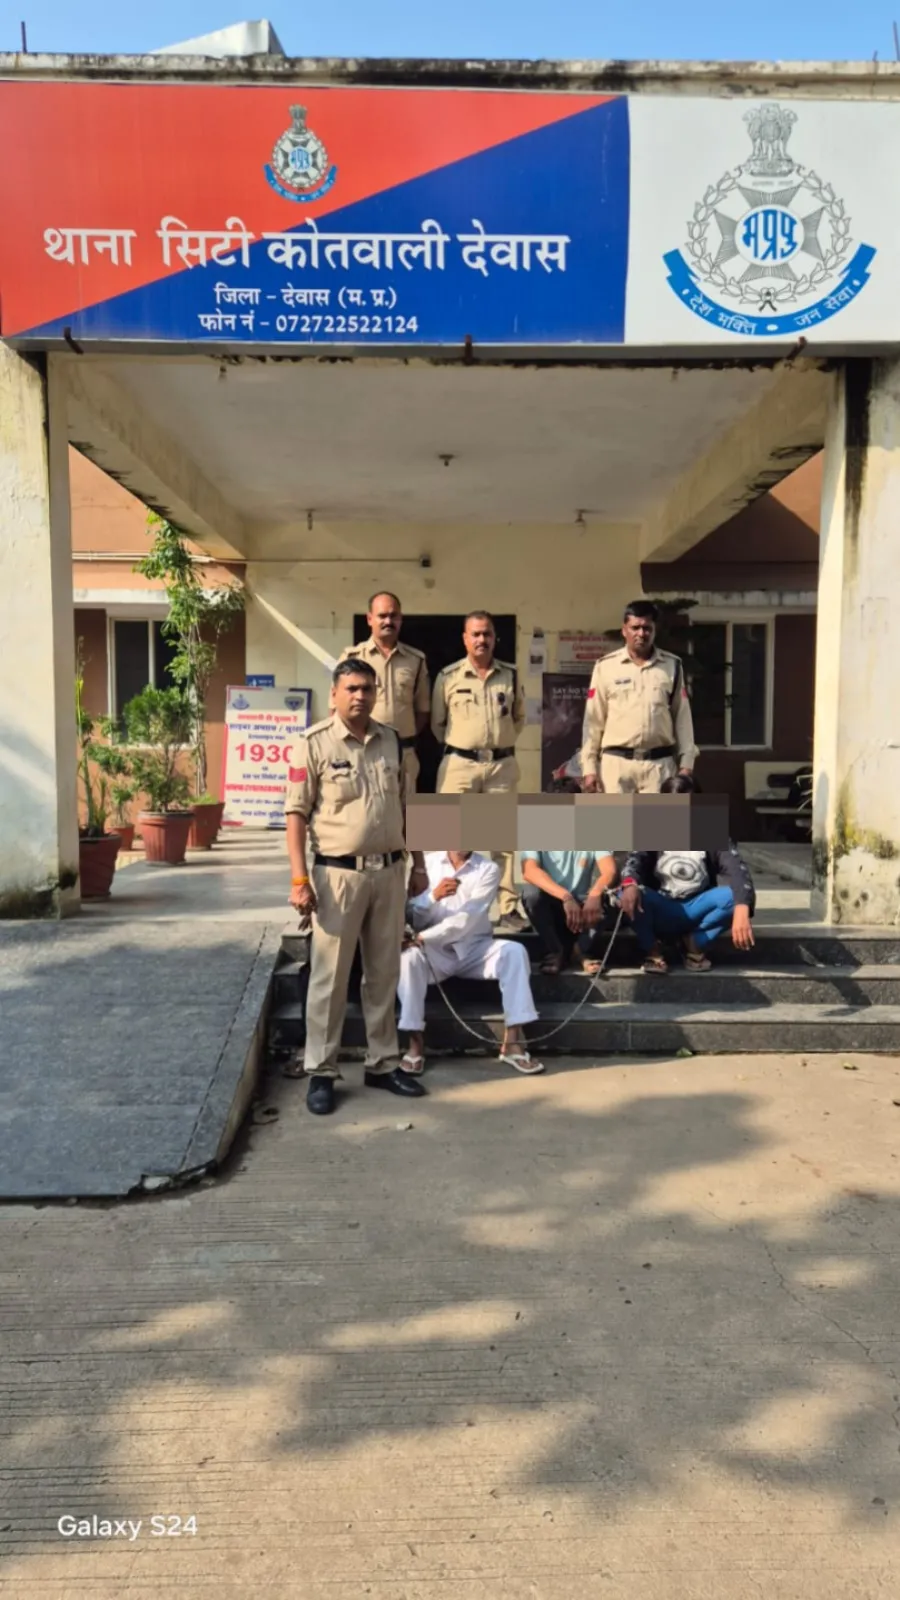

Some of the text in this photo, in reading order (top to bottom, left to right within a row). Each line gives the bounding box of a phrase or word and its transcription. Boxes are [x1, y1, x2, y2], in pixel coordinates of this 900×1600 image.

[43, 215, 571, 277] थाना सिटी कोतवाली देवास
[213, 282, 261, 305] जिला
[281, 282, 331, 308] देवास
[689, 285, 855, 335] देश भक्ति जन सेवा
[198, 308, 237, 332] फोन
[239, 309, 255, 332] नं
[276, 314, 419, 334] 072722522124
